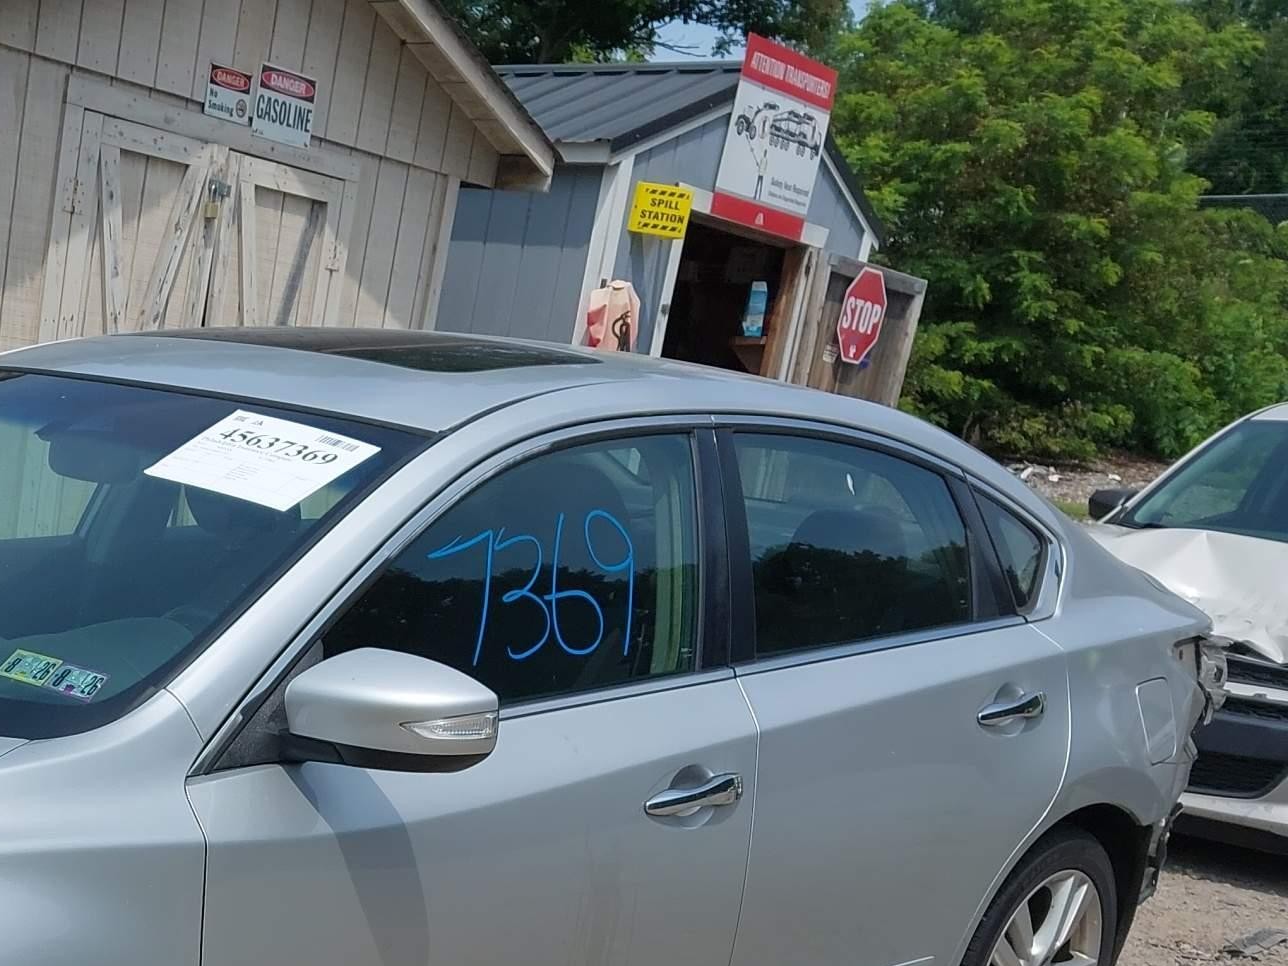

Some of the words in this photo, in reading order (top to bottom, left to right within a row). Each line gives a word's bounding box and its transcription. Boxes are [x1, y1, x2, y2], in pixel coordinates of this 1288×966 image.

[217, 71, 245, 88] DANGER
[271, 74, 306, 95] DANGER
[208, 99, 234, 117] Smoking
[256, 94, 313, 133] GASOLINE
[650, 198, 681, 211] SPILL
[639, 209, 685, 225] STATION
[841, 295, 882, 335] STOP
[219, 428, 339, 465] 45637369
[426, 509, 634, 667] 7369
